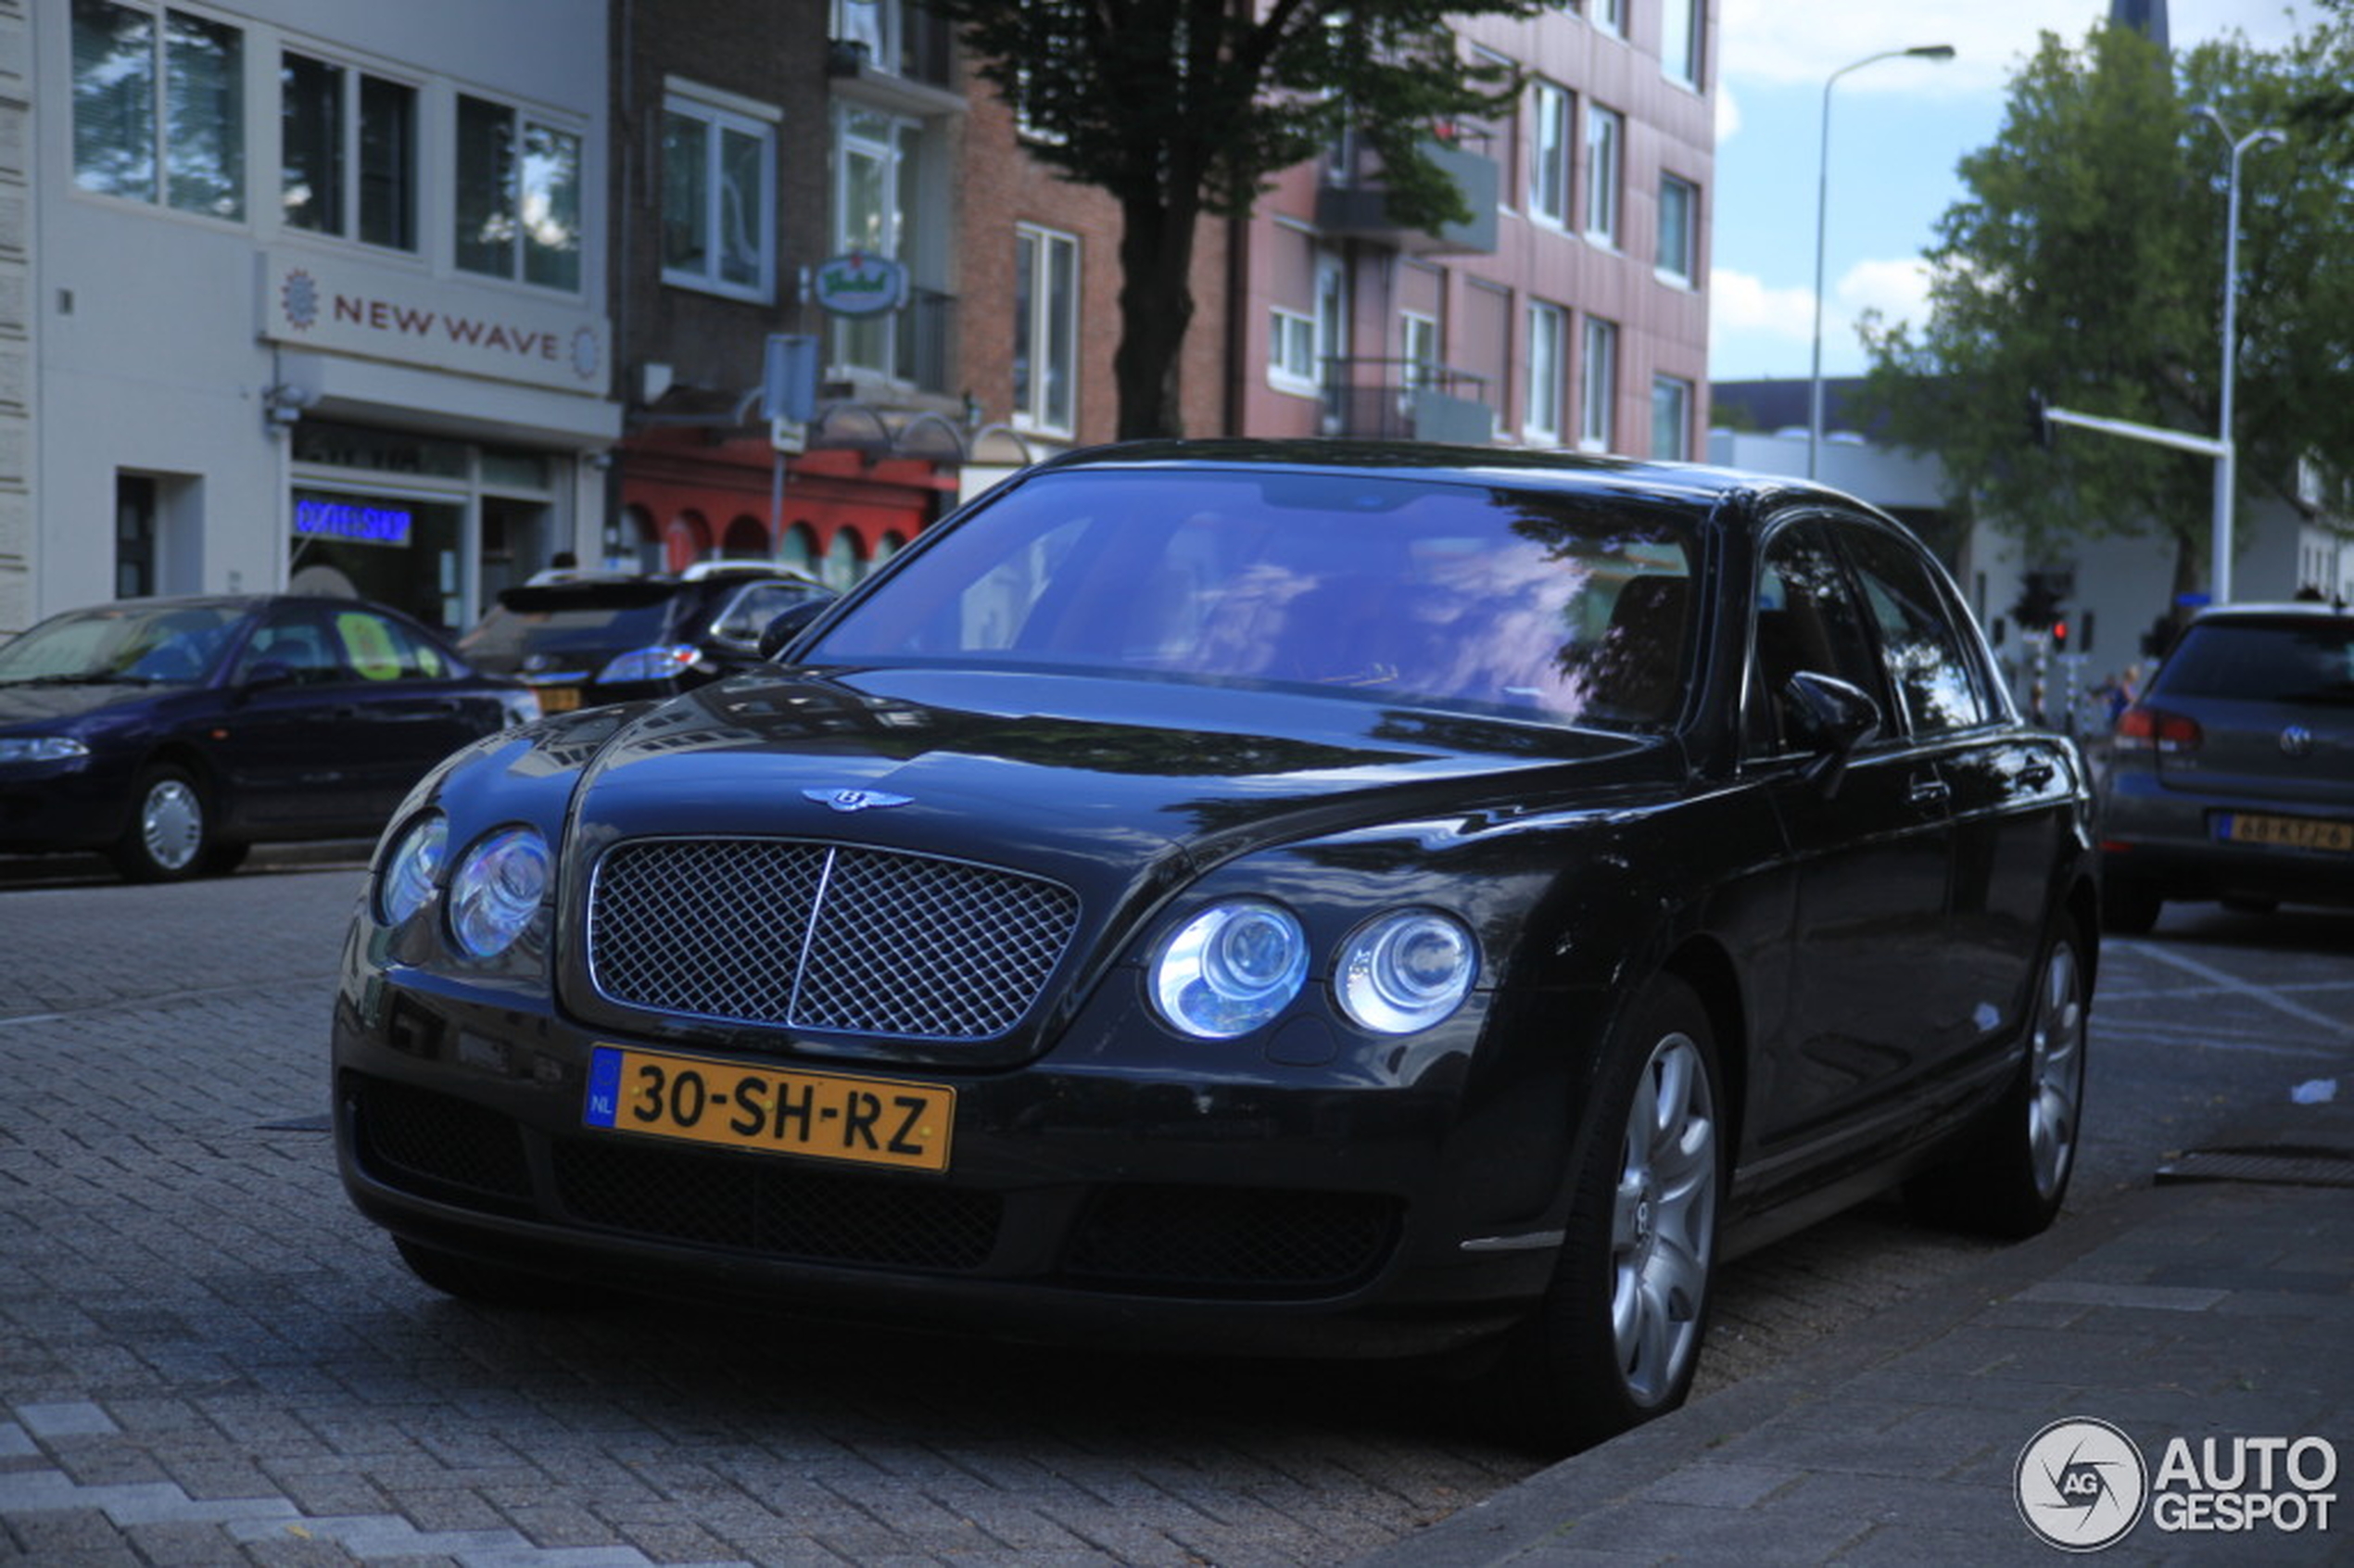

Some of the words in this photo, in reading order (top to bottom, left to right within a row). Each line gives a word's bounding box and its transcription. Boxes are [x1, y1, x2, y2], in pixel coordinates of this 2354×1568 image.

[334, 294, 436, 336] NEW
[443, 315, 558, 360] WAVE
[590, 1094, 613, 1114] NL
[633, 1064, 929, 1156] 30-SH-RZ
